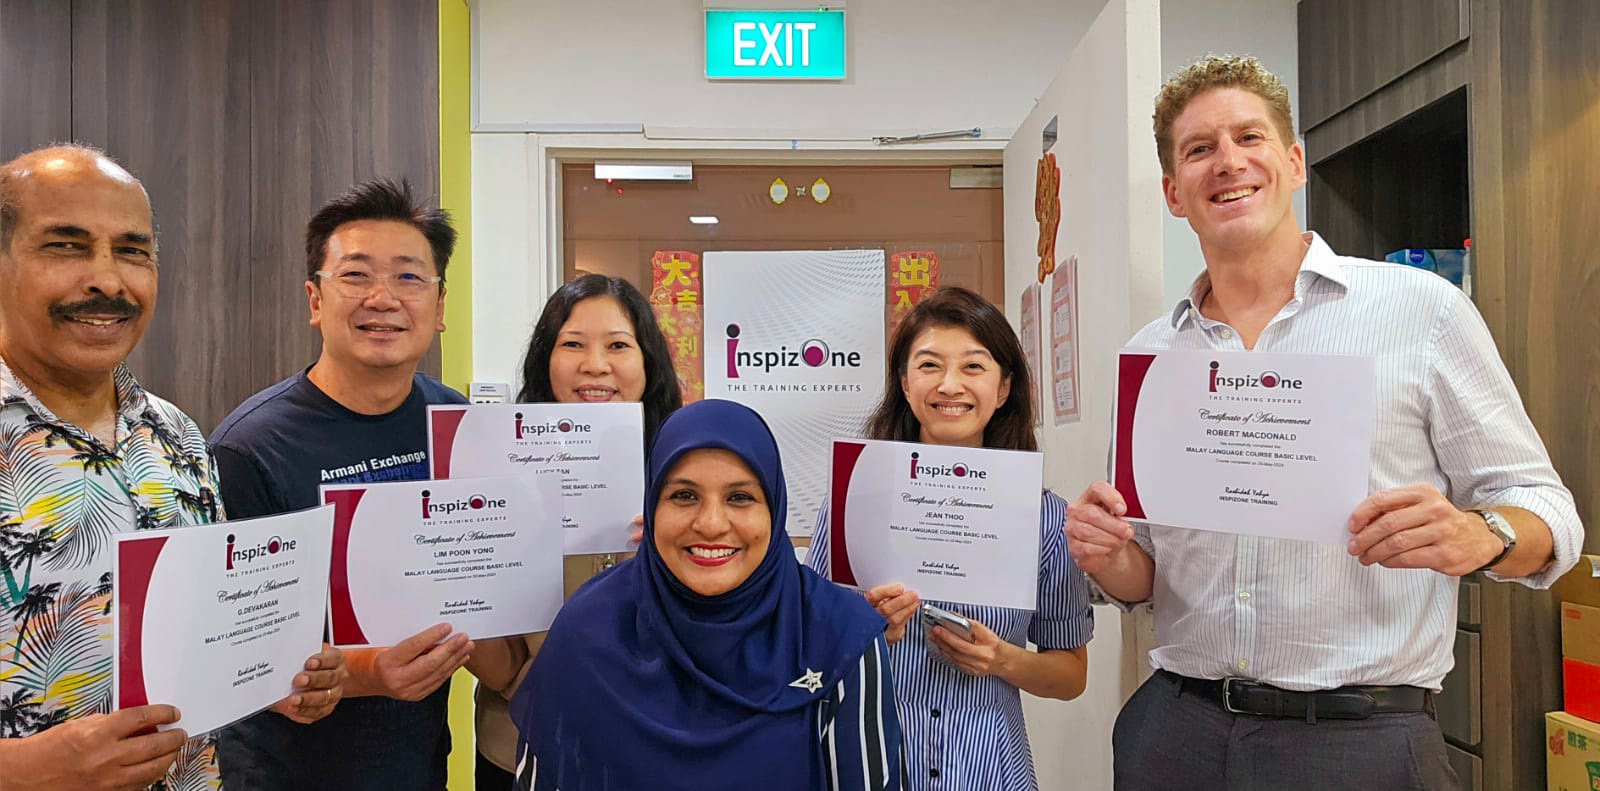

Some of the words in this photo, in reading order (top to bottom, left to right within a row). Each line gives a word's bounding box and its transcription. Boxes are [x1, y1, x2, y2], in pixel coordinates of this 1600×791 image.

[733, 22, 816, 67] EXIT
[727, 384, 747, 392] THE
[754, 384, 807, 392] TRAINING
[813, 384, 862, 392] EXPERTS
[1198, 408, 1241, 424] Certificate
[1242, 413, 1252, 425] of
[1252, 412, 1311, 425] Achievement
[1206, 429, 1240, 438] ROBERT
[1242, 430, 1297, 441] MACDONALD
[508, 453, 544, 465] Certificate
[545, 454, 554, 464] of
[554, 452, 600, 462] Achievement
[1186, 446, 1207, 454] MALAY
[1208, 448, 1243, 457] LANGUAGE
[1245, 450, 1272, 459] COURSE
[1274, 452, 1294, 460] BASIC
[1295, 454, 1318, 462] LEVEL
[321, 461, 368, 481] Armani
[369, 450, 426, 470] Exchange
[901, 492, 937, 506] Certificate
[938, 498, 946, 508] of
[944, 496, 994, 510] Achievement
[1218, 496, 1249, 504] INSPIZONE
[1250, 498, 1278, 506] TRAINING
[944, 513, 964, 521] THOO
[414, 534, 455, 546] Certificate
[456, 534, 466, 545] of
[464, 530, 516, 542] Achievement
[909, 526, 938, 535] LANGUAGE
[980, 532, 998, 540] LEVEL
[449, 549, 471, 557] POON
[472, 547, 495, 555] YONG
[426, 567, 460, 576] LANGUAGE
[460, 564, 485, 572] COURSE
[486, 562, 504, 570] BASIC
[916, 568, 943, 576] INSPIZONE
[217, 590, 252, 604] Certificate
[252, 586, 261, 600] of
[260, 577, 300, 594] Achievement
[238, 600, 279, 616] G.DEVAKARAN
[440, 608, 467, 616] INSPIZONE
[205, 634, 224, 644] MALAY
[226, 626, 254, 639] LANGUAGE
[254, 620, 274, 631] COURSE
[274, 616, 287, 625] BASIC
[287, 611, 300, 620] LEVEL
[232, 674, 254, 687] INSPIZONE
[256, 666, 274, 678] TRAINING
